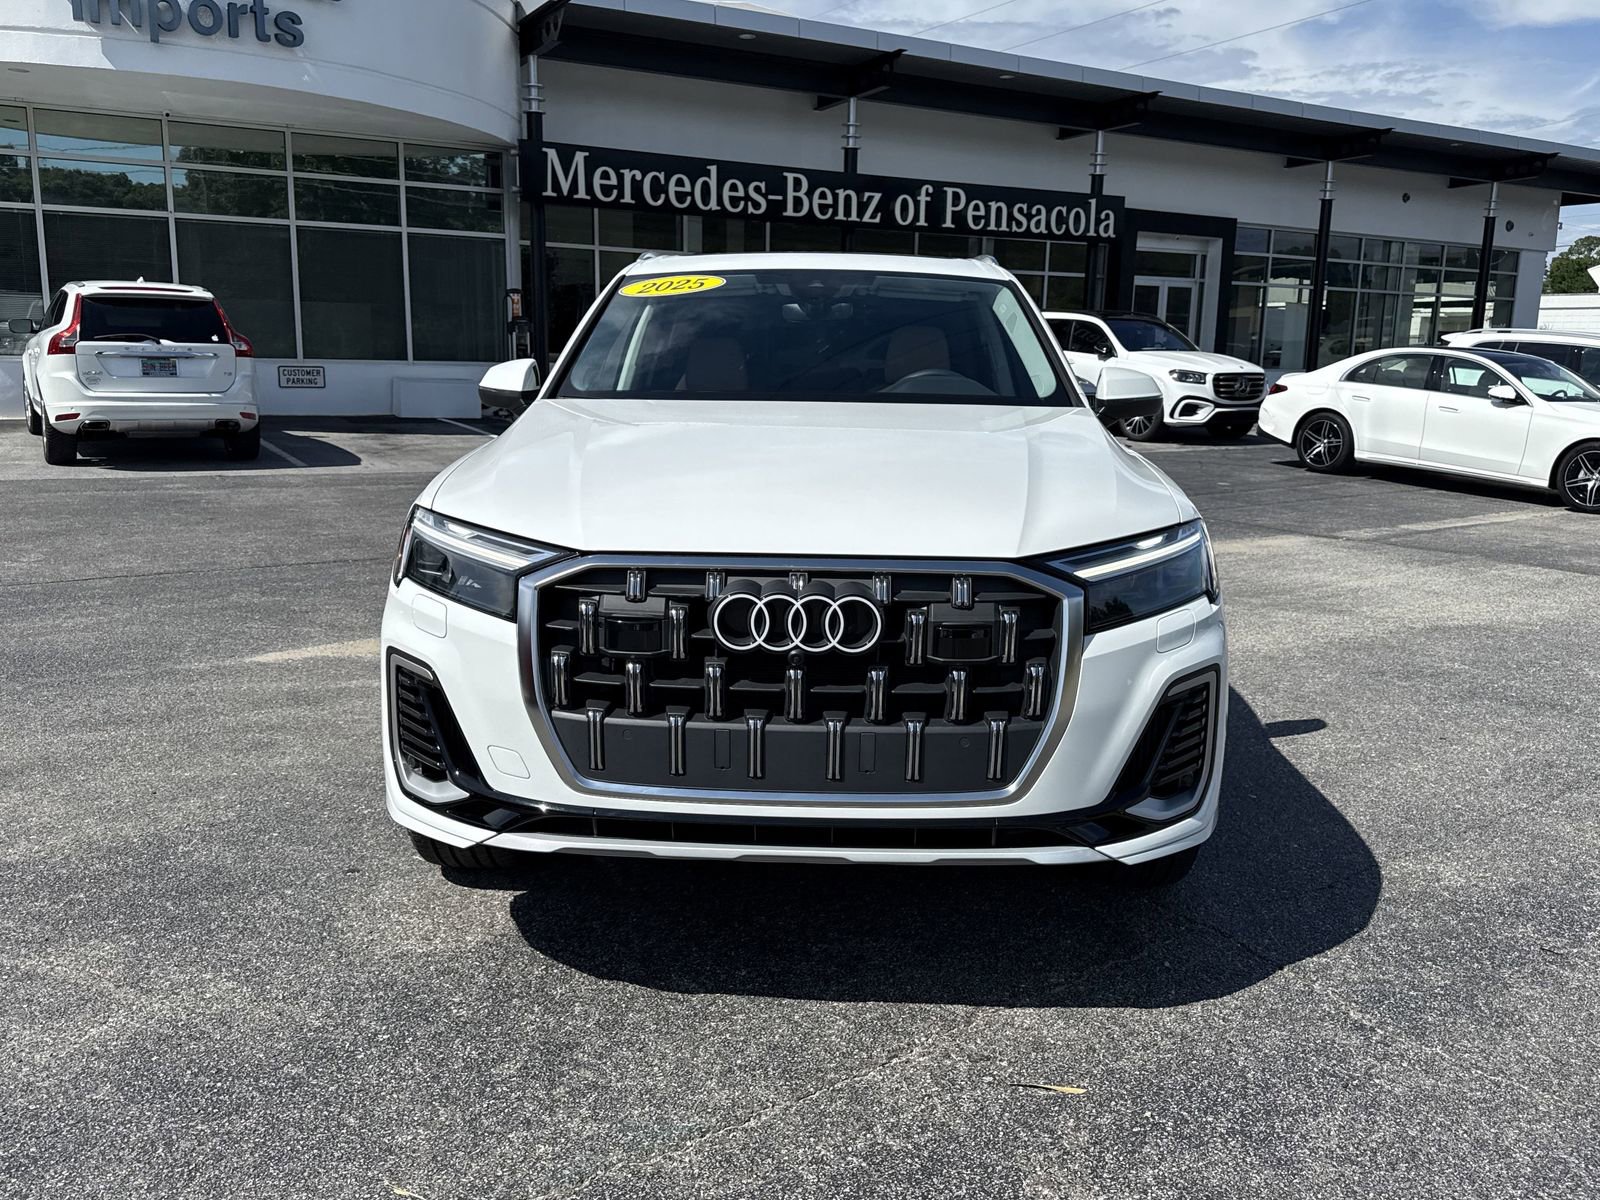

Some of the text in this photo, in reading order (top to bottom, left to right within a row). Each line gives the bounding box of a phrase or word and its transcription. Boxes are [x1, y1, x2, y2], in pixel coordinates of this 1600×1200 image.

[541, 147, 1117, 239] Mercedes-Benz of Pensacola
[636, 278, 708, 294] 2025
[282, 368, 321, 377] CUSTOMER
[286, 377, 318, 386] PARKING
